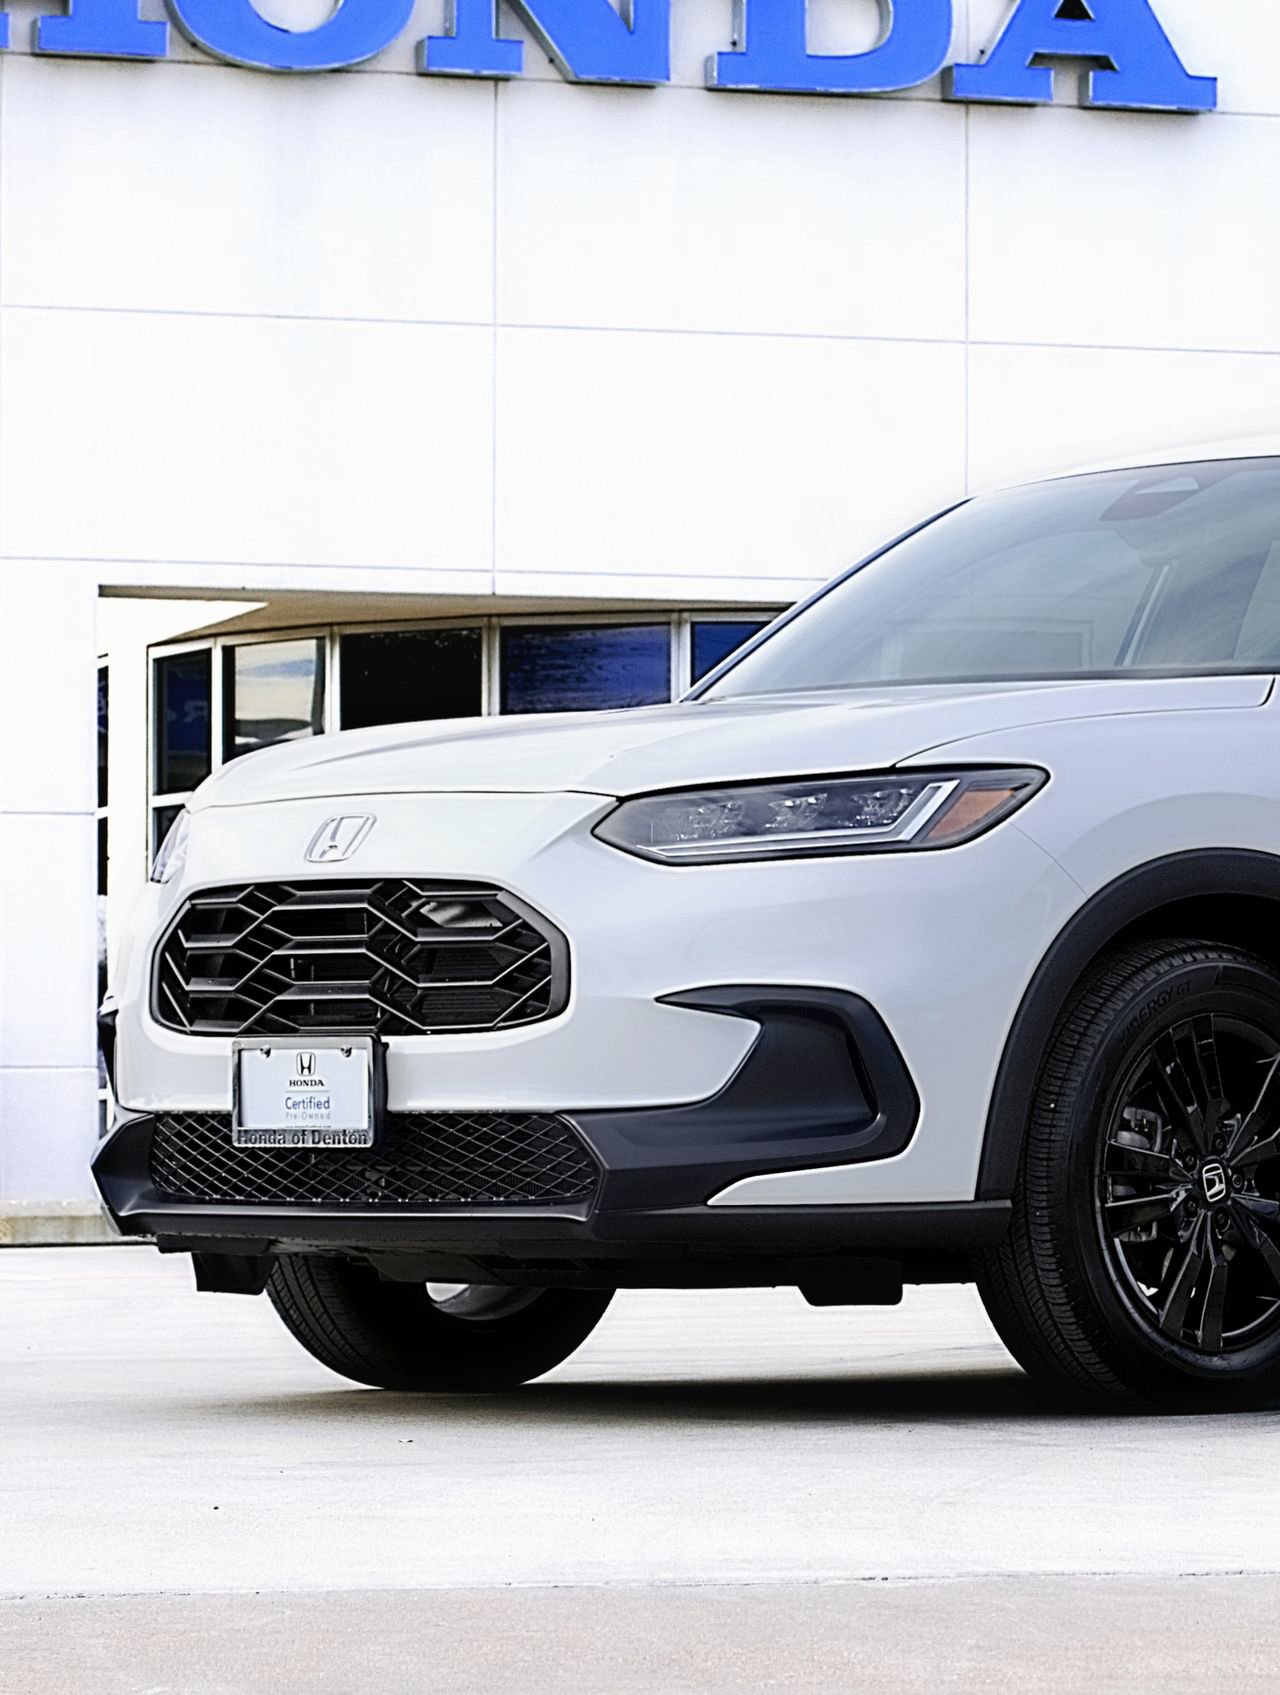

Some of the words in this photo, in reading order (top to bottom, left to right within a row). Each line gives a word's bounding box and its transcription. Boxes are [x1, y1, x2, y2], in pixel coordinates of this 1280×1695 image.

[289, 1079, 325, 1087] HONDA
[285, 1095, 331, 1110] Certified
[286, 1111, 331, 1120] Pre-Owned
[237, 1129, 286, 1145] Honda
[291, 1129, 307, 1145] of
[311, 1129, 367, 1145] Denton
